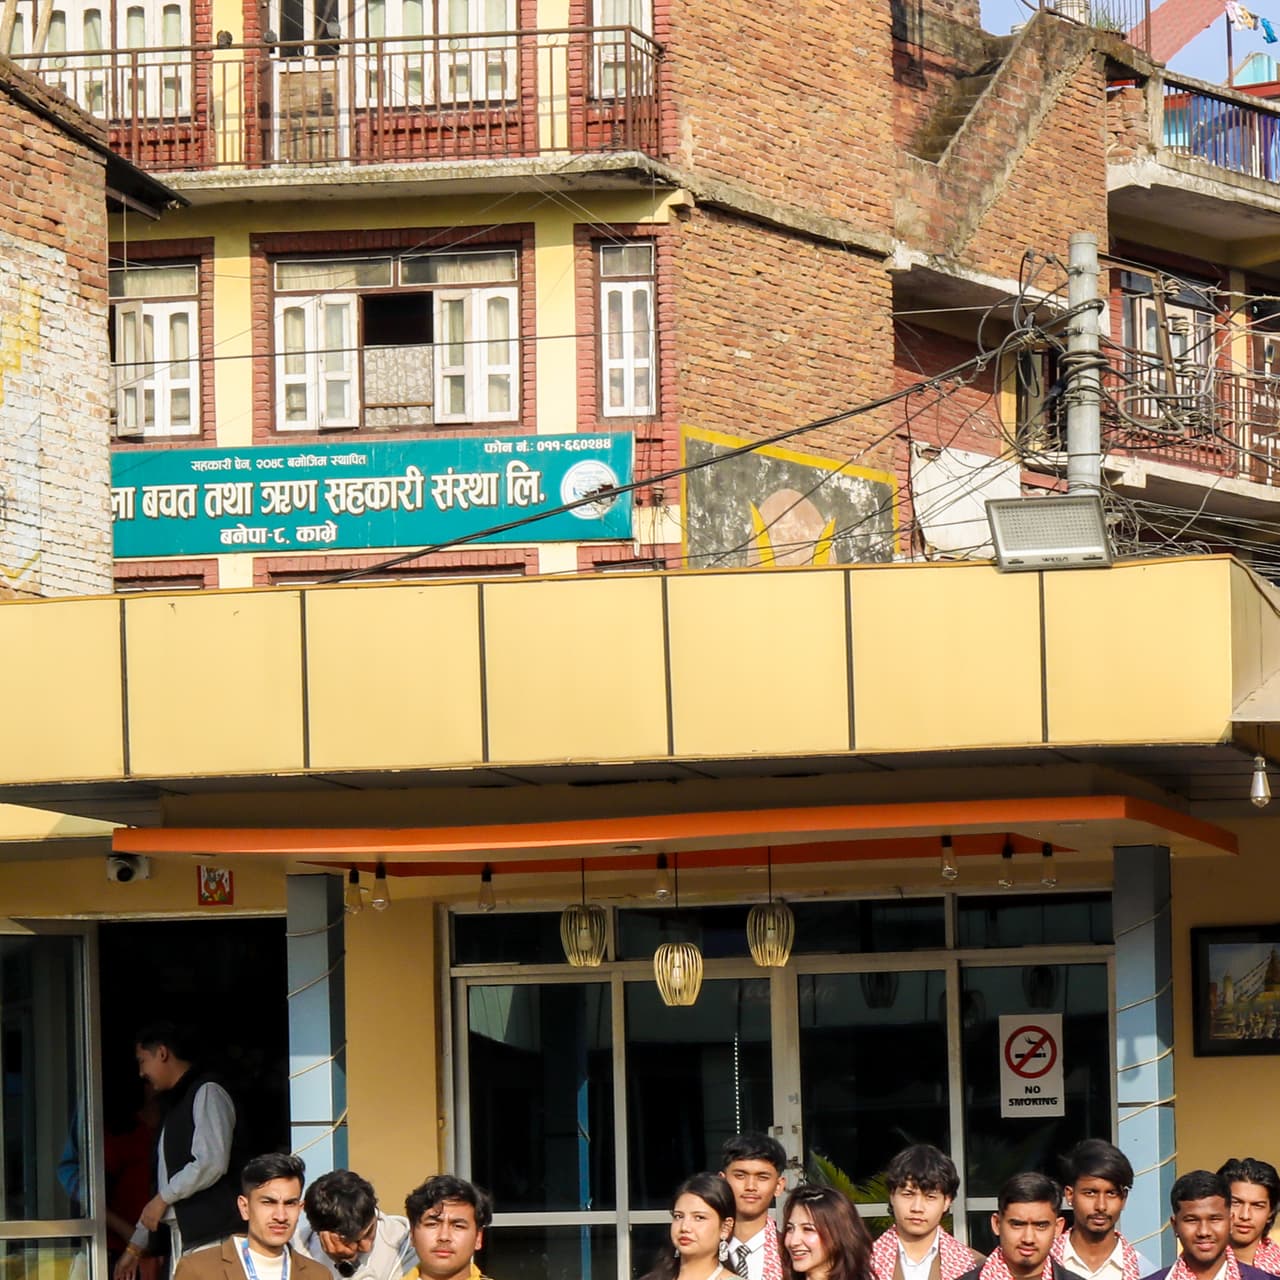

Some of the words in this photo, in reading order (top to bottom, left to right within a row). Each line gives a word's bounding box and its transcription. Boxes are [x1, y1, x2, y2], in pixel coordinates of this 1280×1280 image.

[484, 439, 513, 453] फोन
[190, 457, 232, 472] सहकारी
[287, 454, 327, 468] बमोजिम
[330, 452, 367, 467] स्थापित
[142, 484, 198, 520] बचत
[204, 482, 254, 518] तथा
[260, 479, 319, 516] ऋण
[324, 465, 425, 515] सहकारी
[431, 467, 500, 511] संस्था
[507, 459, 546, 507] लि.
[1024, 1085, 1041, 1094] NO
[1008, 1097, 1058, 1107] SMOKING
